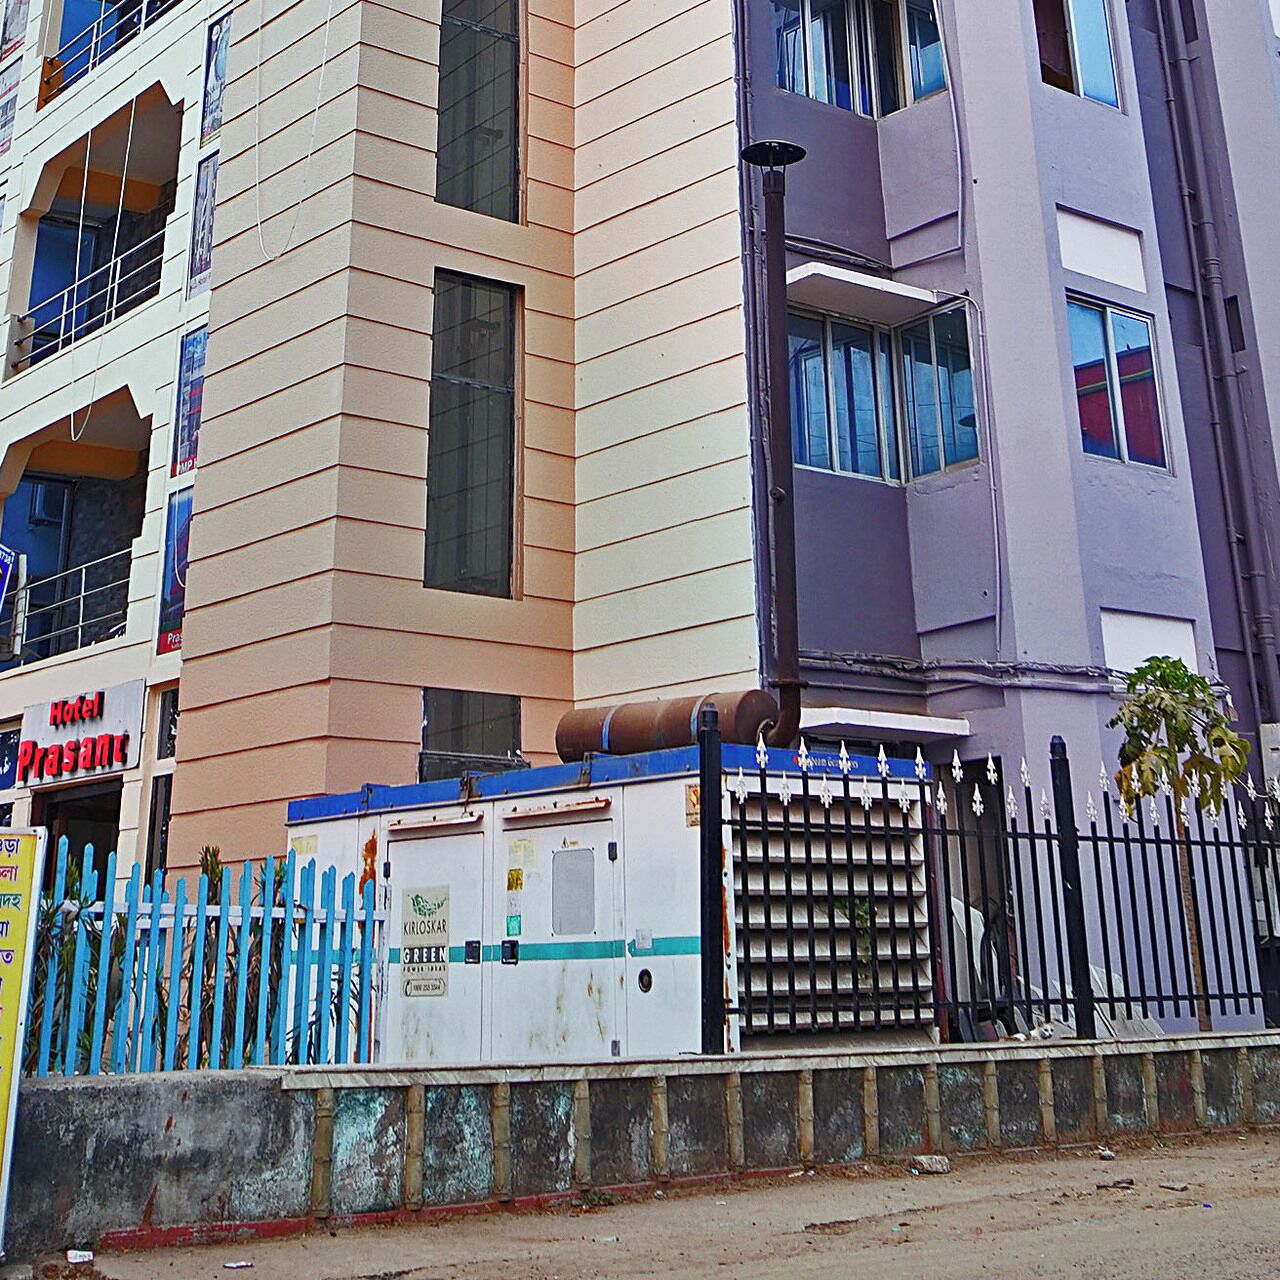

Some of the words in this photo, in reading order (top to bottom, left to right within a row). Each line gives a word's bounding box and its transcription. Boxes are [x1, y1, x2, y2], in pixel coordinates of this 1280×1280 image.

[49, 689, 105, 729] Hotel
[403, 918, 448, 936] KIRLOSKAR
[403, 946, 447, 964] GREEN
